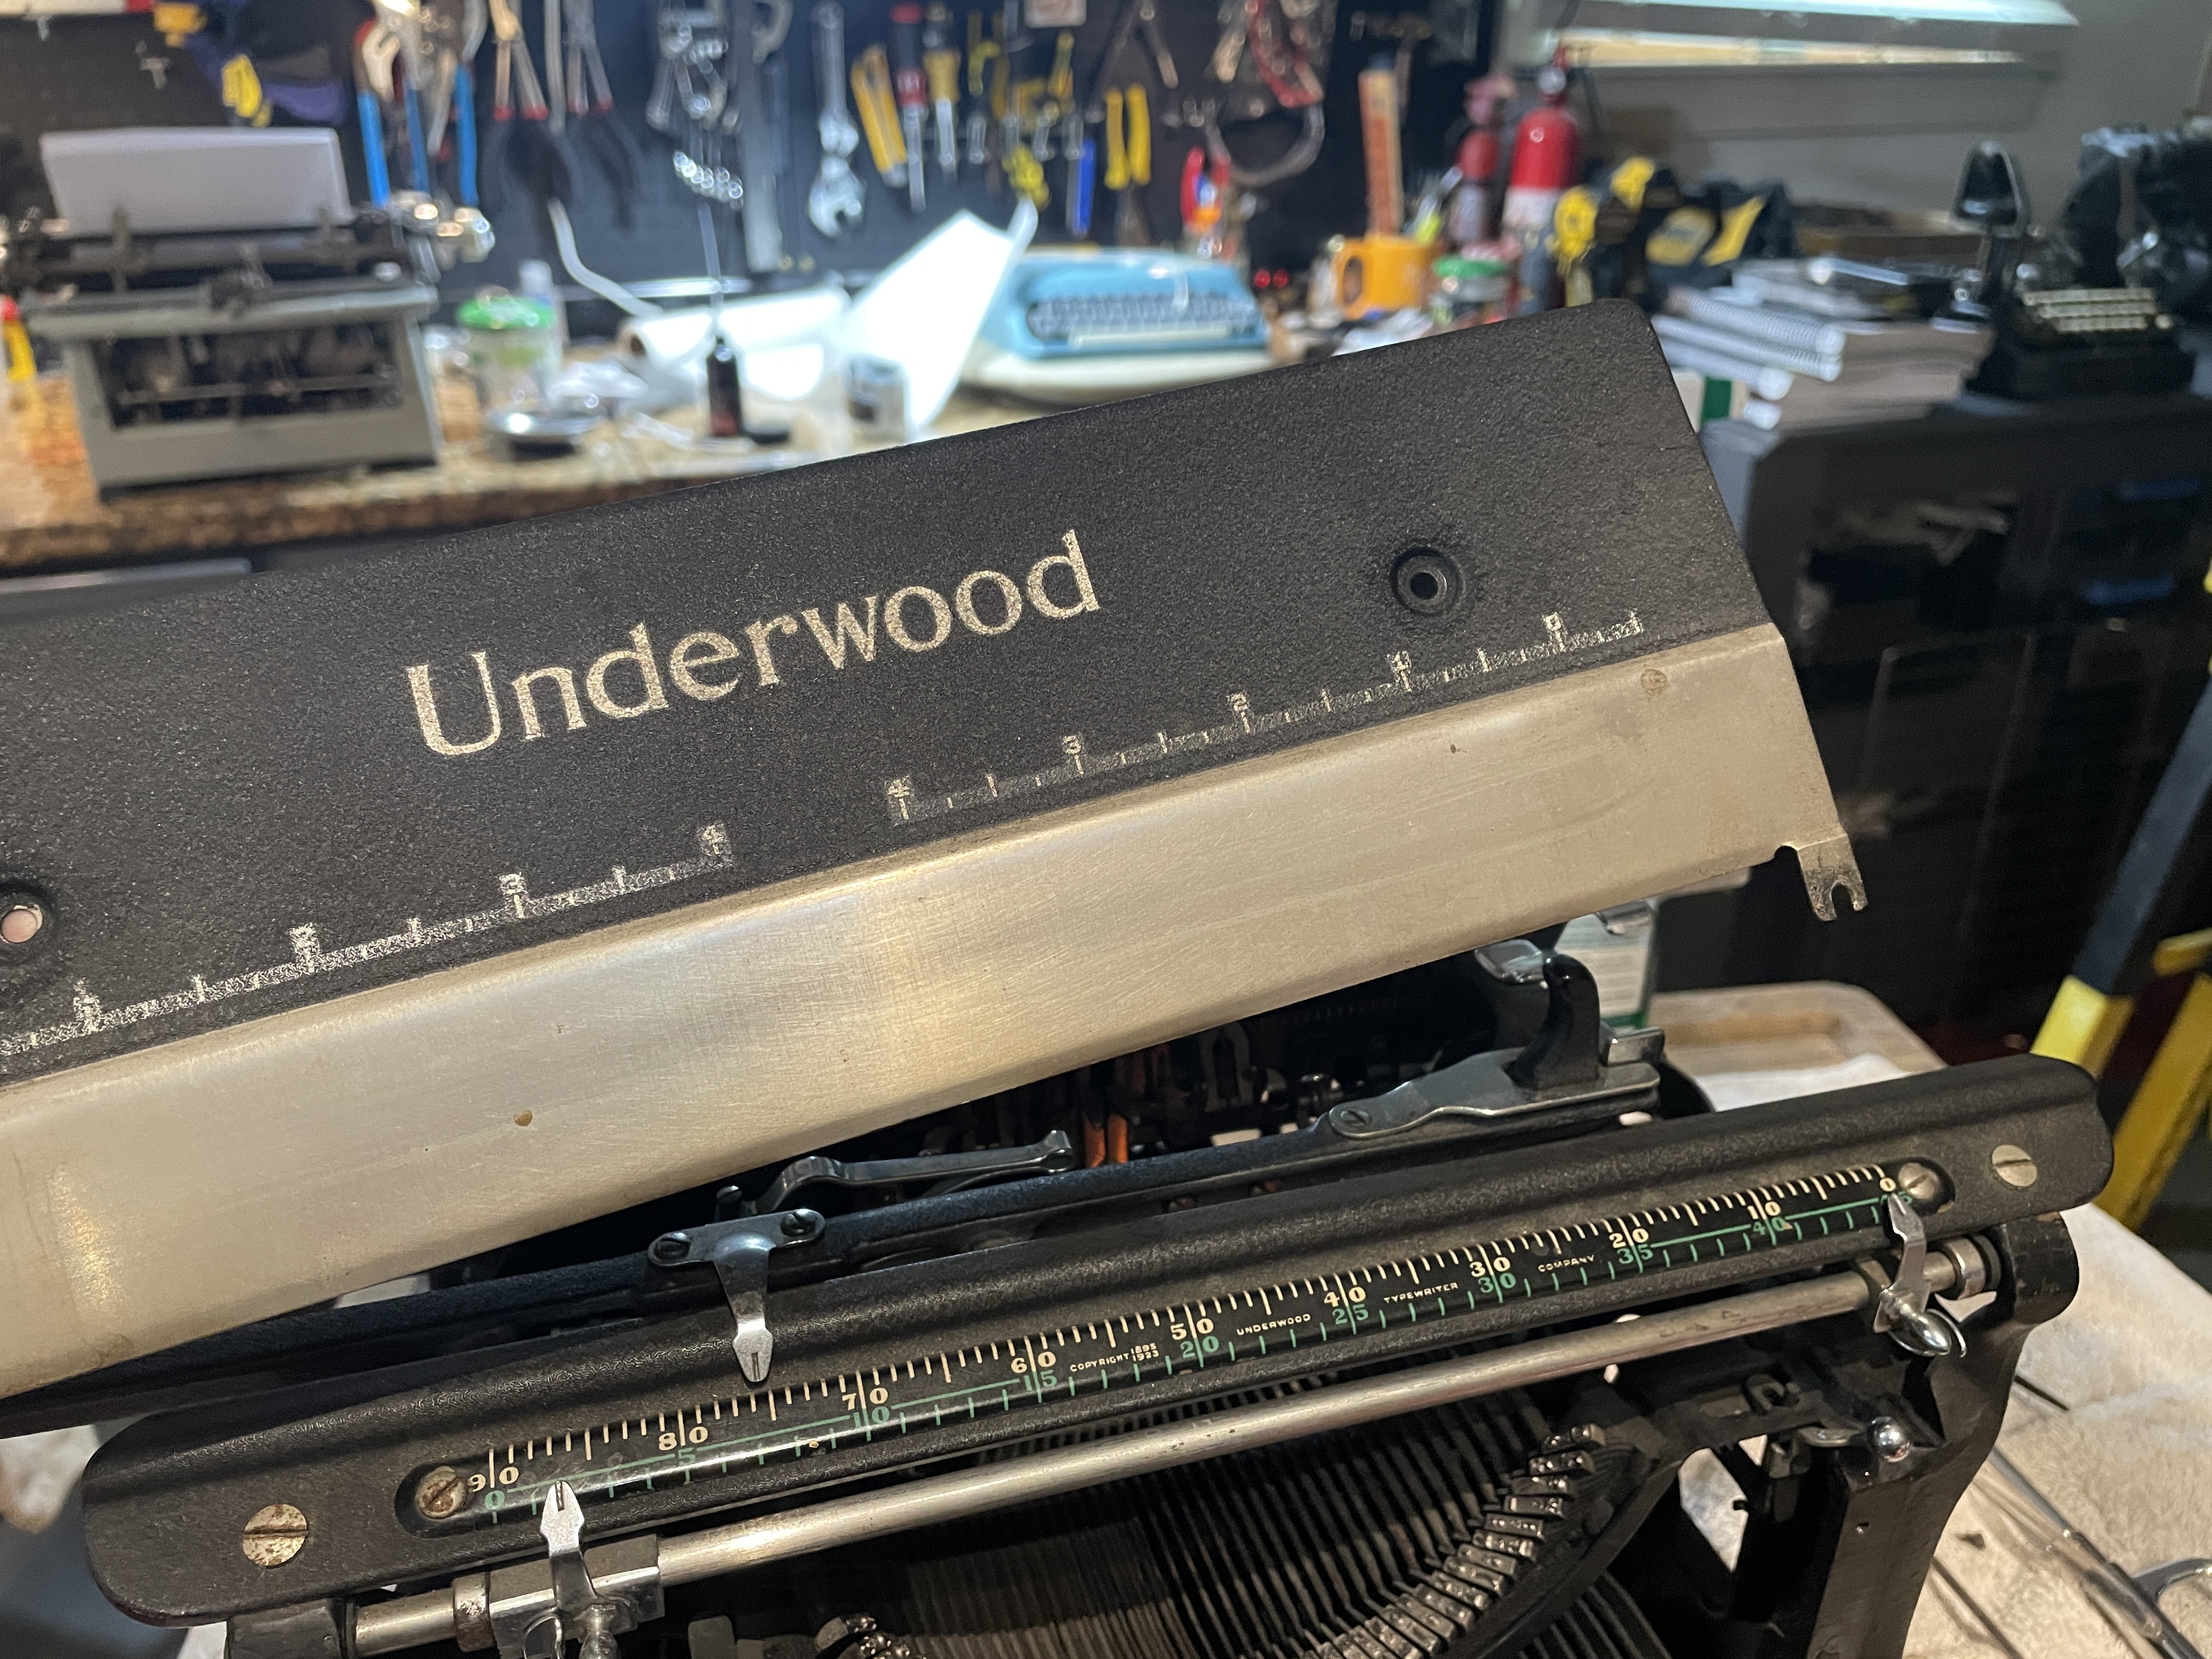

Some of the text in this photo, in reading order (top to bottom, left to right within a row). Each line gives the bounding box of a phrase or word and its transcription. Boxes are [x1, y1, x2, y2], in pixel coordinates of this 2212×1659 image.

[407, 528, 1101, 756] Underwood
[1236, 1255, 1595, 1336] UNDERWOOD TYPEWRITER COMPANY
[1070, 1353, 1130, 1372] COPYRIGHT
[484, 1489, 504, 1510] 0
[678, 1446, 696, 1466] 5
